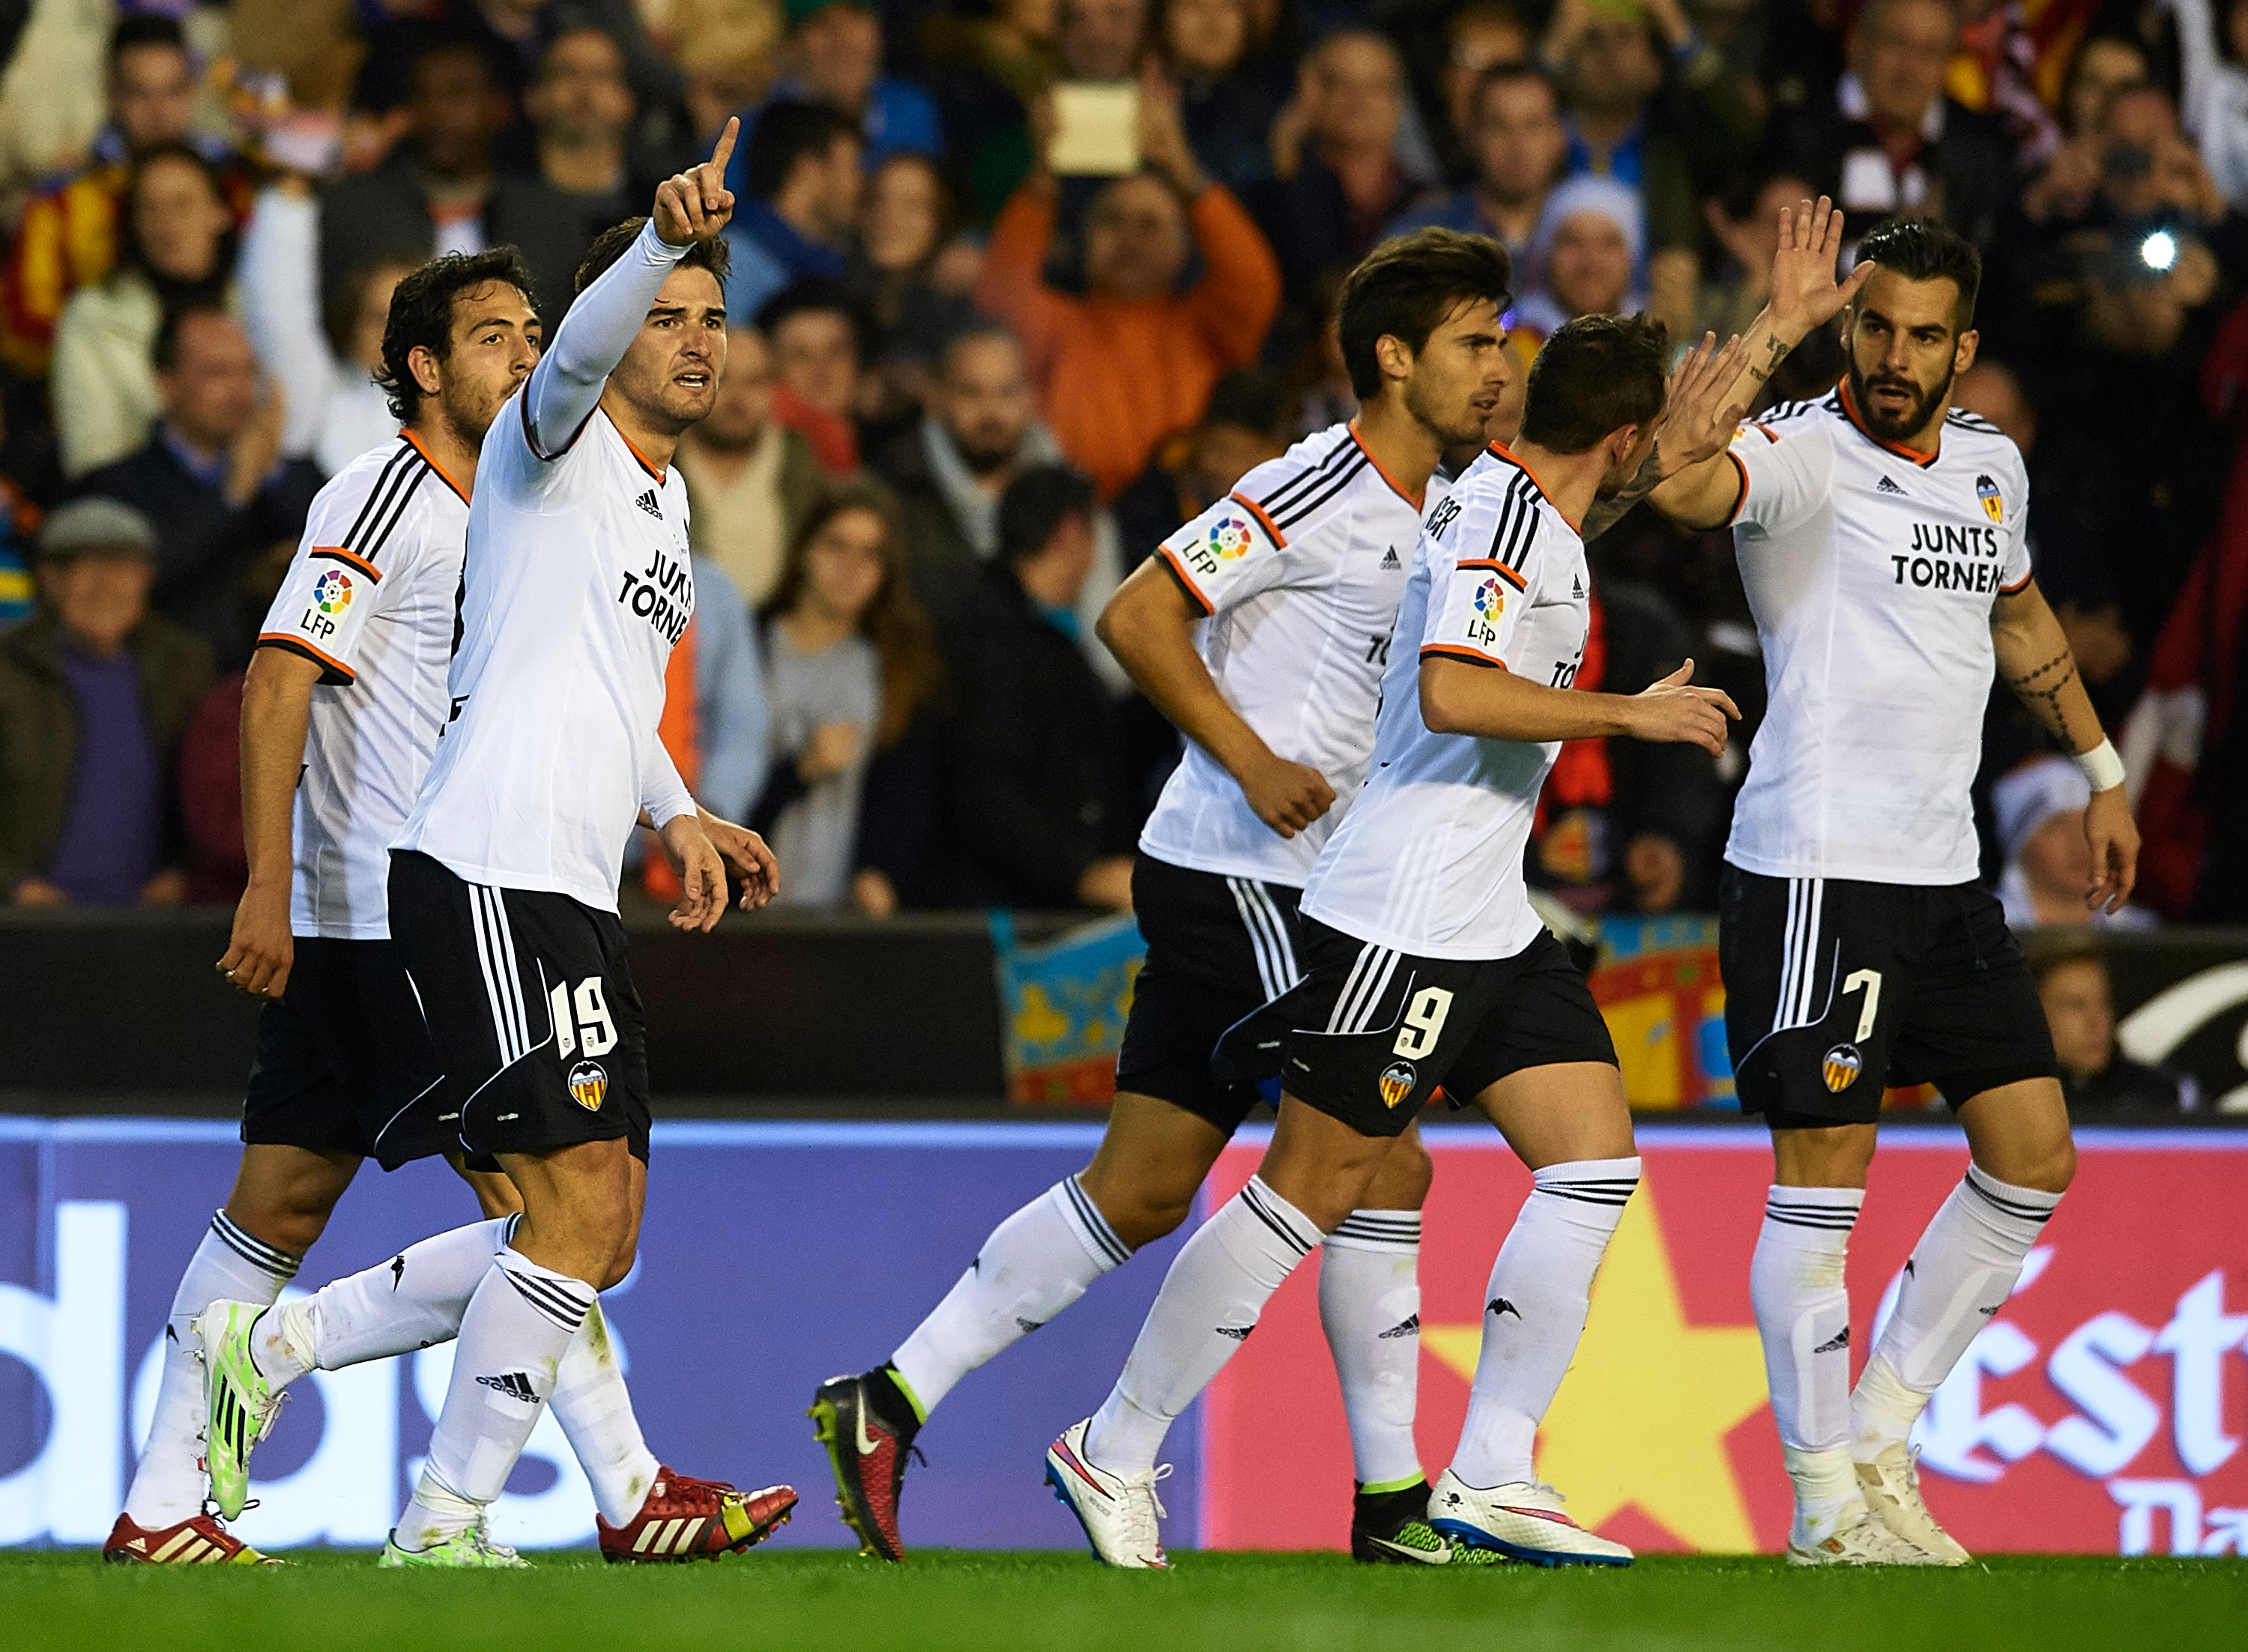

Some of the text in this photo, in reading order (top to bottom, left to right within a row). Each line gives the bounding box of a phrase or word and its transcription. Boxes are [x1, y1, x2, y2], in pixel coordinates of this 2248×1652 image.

[635, 499, 663, 521] adidas
[1183, 539, 1218, 574] LFP
[1912, 523, 1998, 558] JUNTS
[300, 608, 336, 640] LFP
[1467, 619, 1496, 647] LFP
[1550, 661, 1577, 689] TO
[550, 976, 619, 1061] 19
[1842, 968, 1882, 1044] 7
[1392, 986, 1454, 1061] 9
[475, 1376, 541, 1404] adidas
